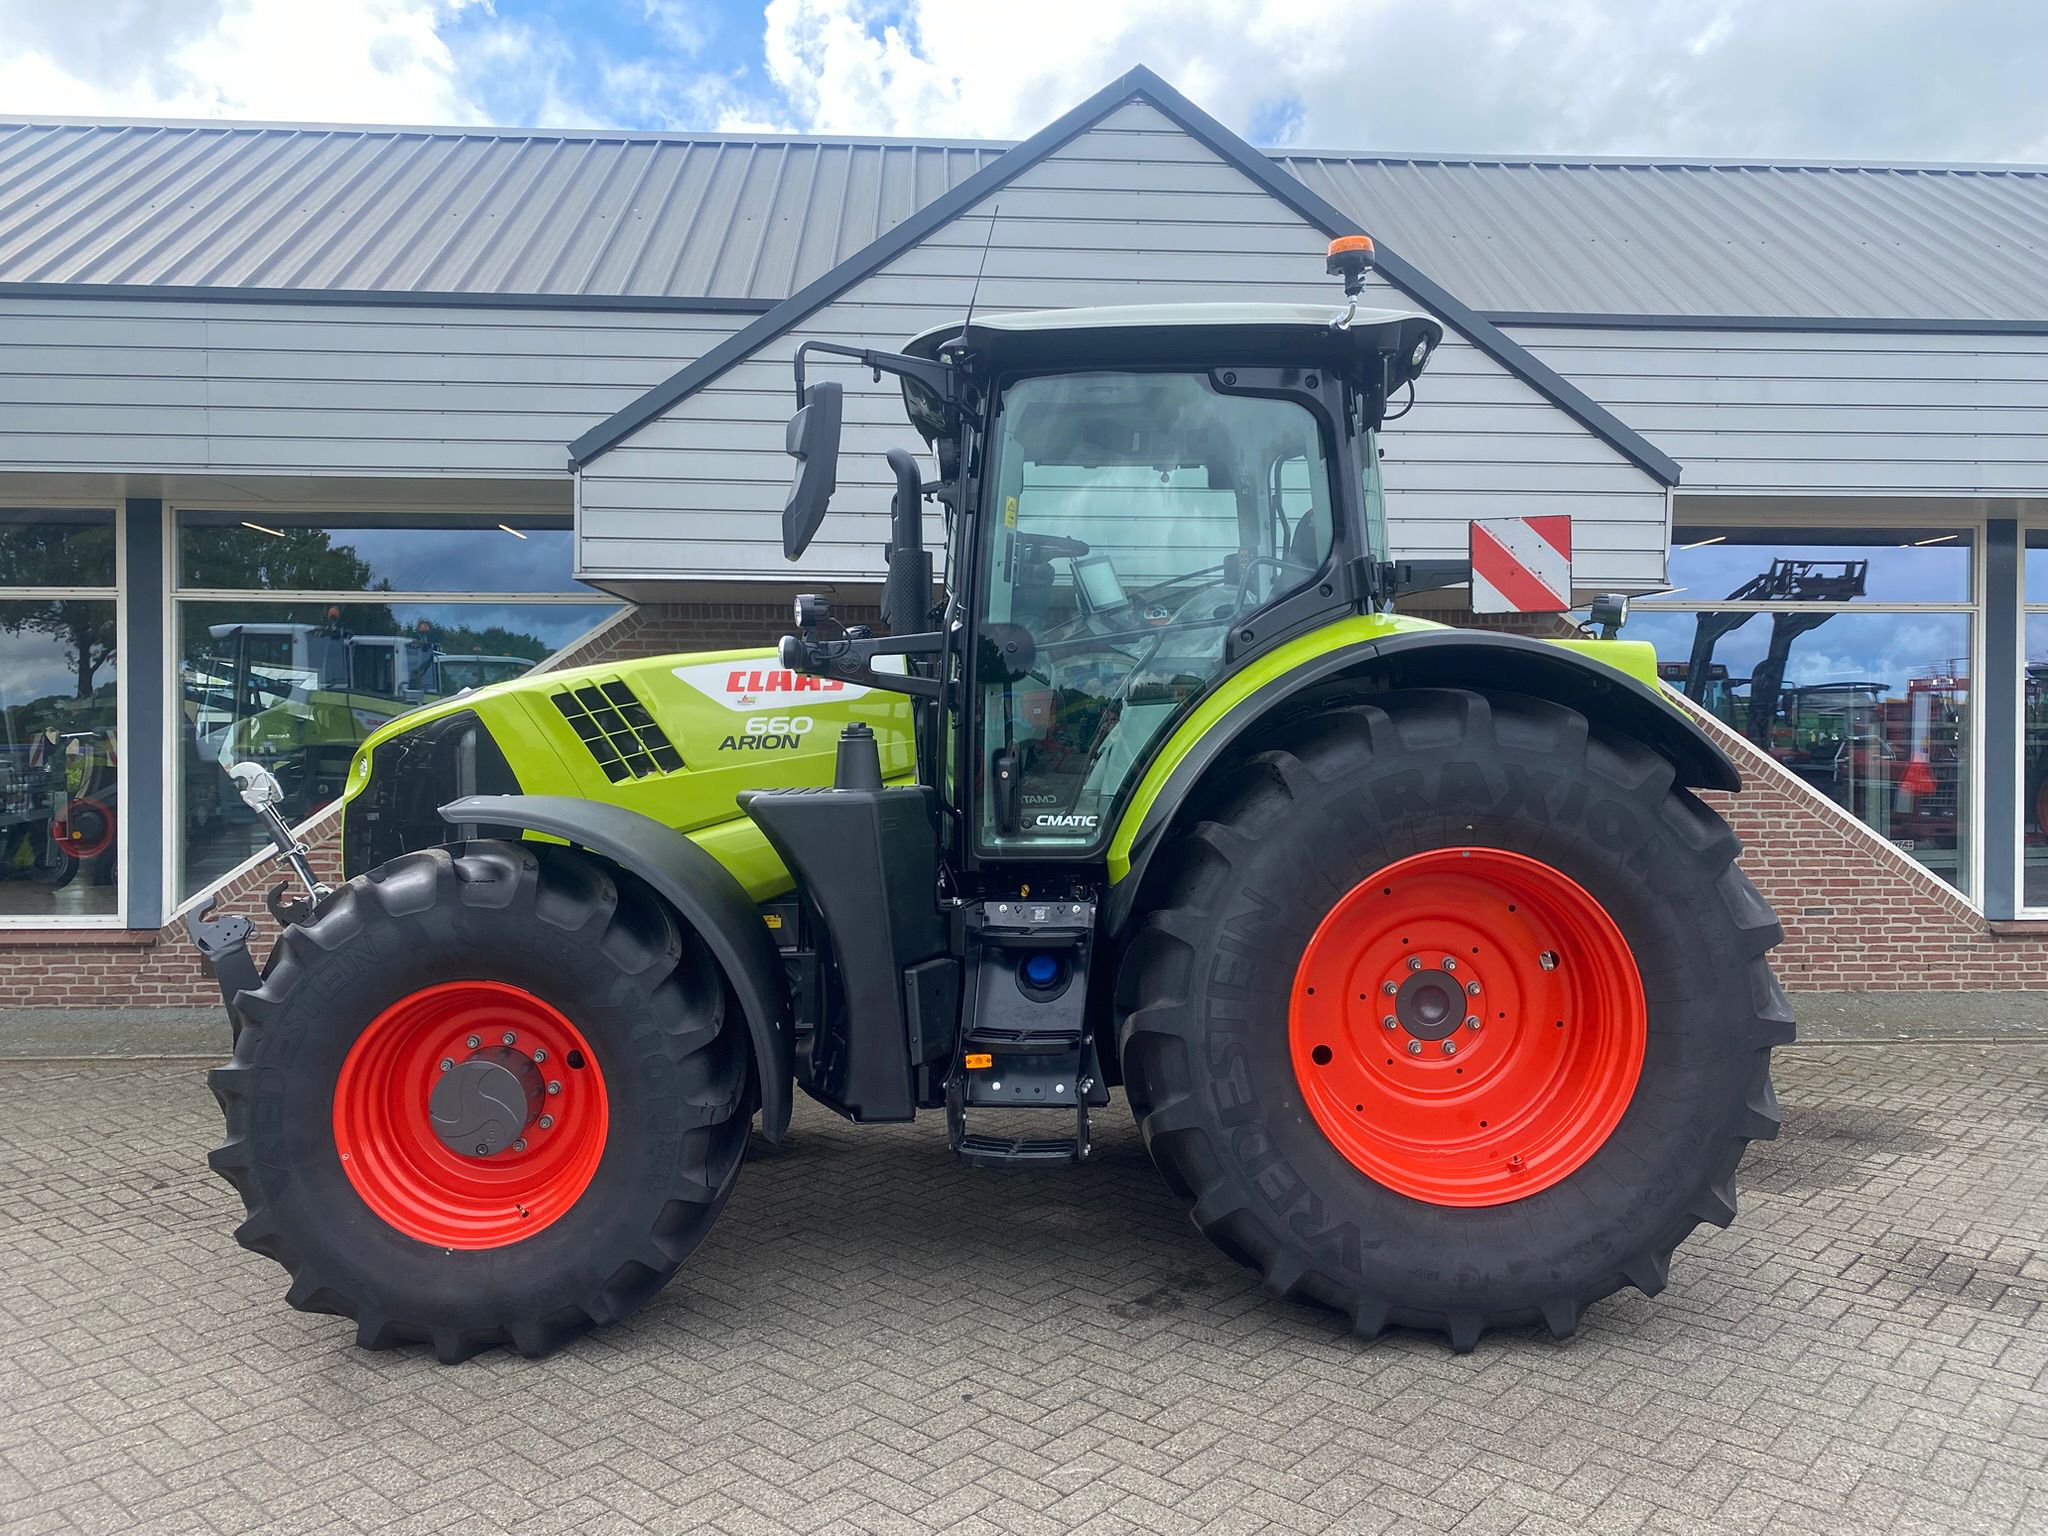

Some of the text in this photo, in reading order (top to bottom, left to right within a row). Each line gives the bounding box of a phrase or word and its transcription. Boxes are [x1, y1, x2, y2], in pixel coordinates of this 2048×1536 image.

[745, 716, 813, 735] 660
[718, 734, 800, 750] ARION
[1036, 815, 1098, 827] CMATIC
[1206, 886, 1361, 1276] VREDESTEIN
